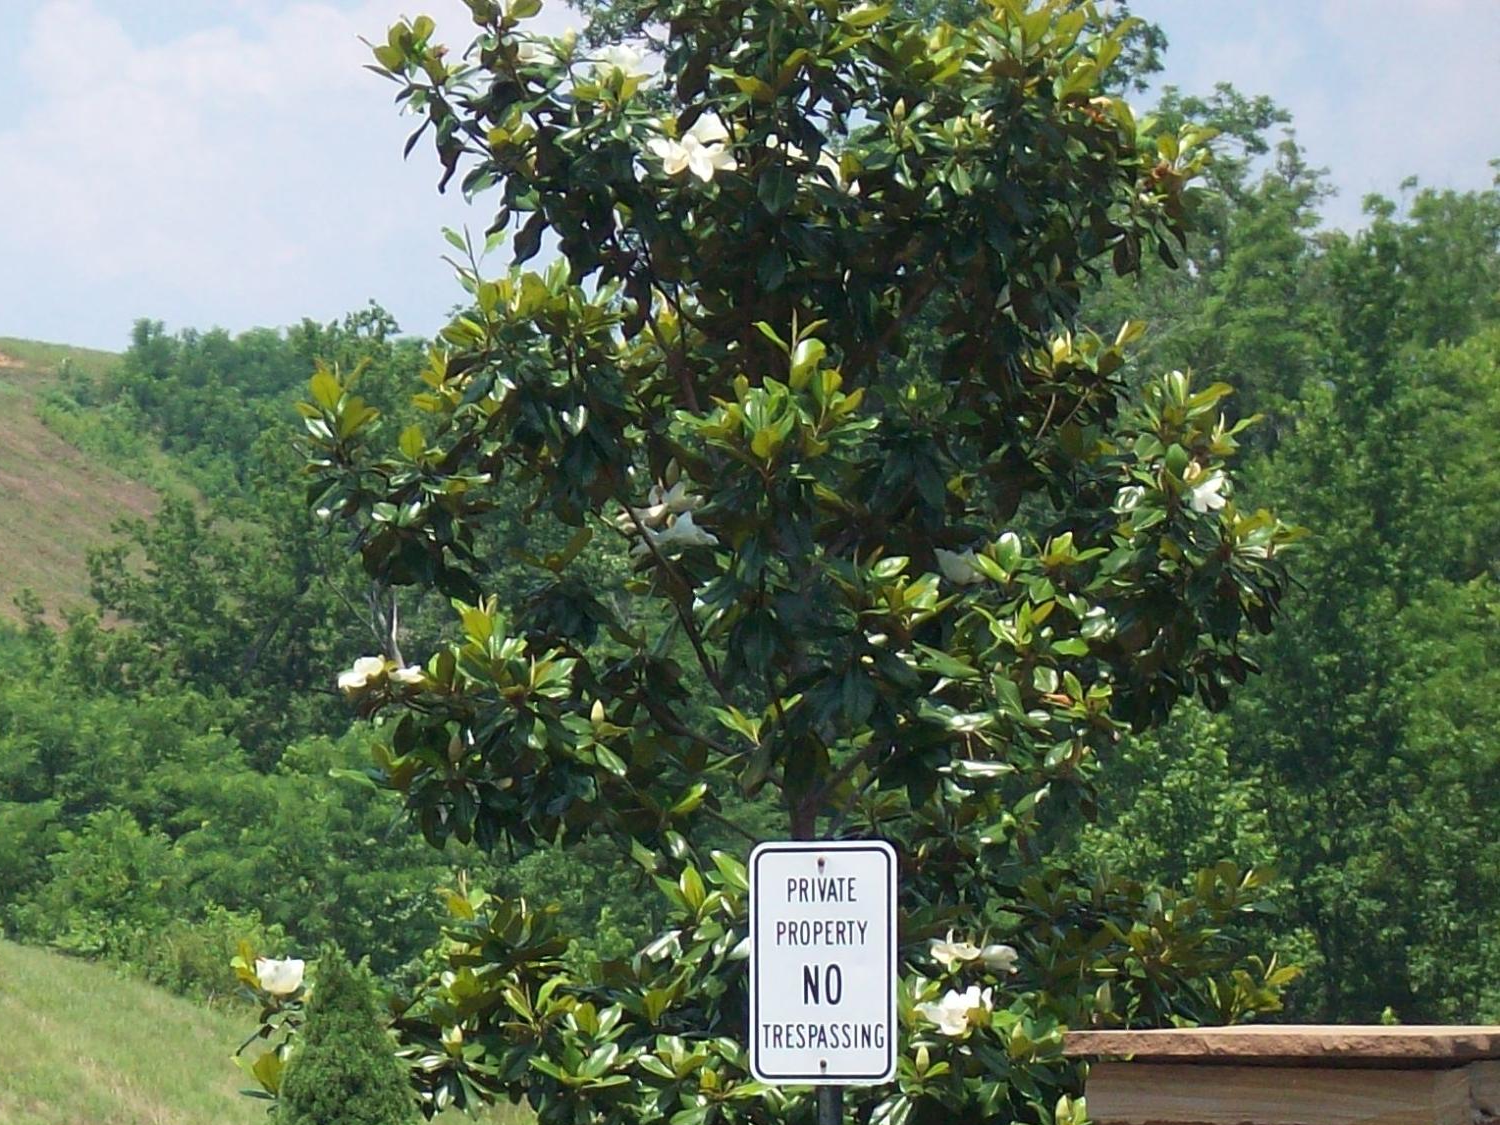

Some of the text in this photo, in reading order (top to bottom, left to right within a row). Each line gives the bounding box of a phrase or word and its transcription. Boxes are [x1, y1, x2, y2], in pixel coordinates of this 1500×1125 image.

[787, 877, 857, 902] PRIVATE
[776, 920, 868, 946] PROPERTY
[803, 963, 843, 1006] NO
[762, 1023, 885, 1049] TRESPASSING
